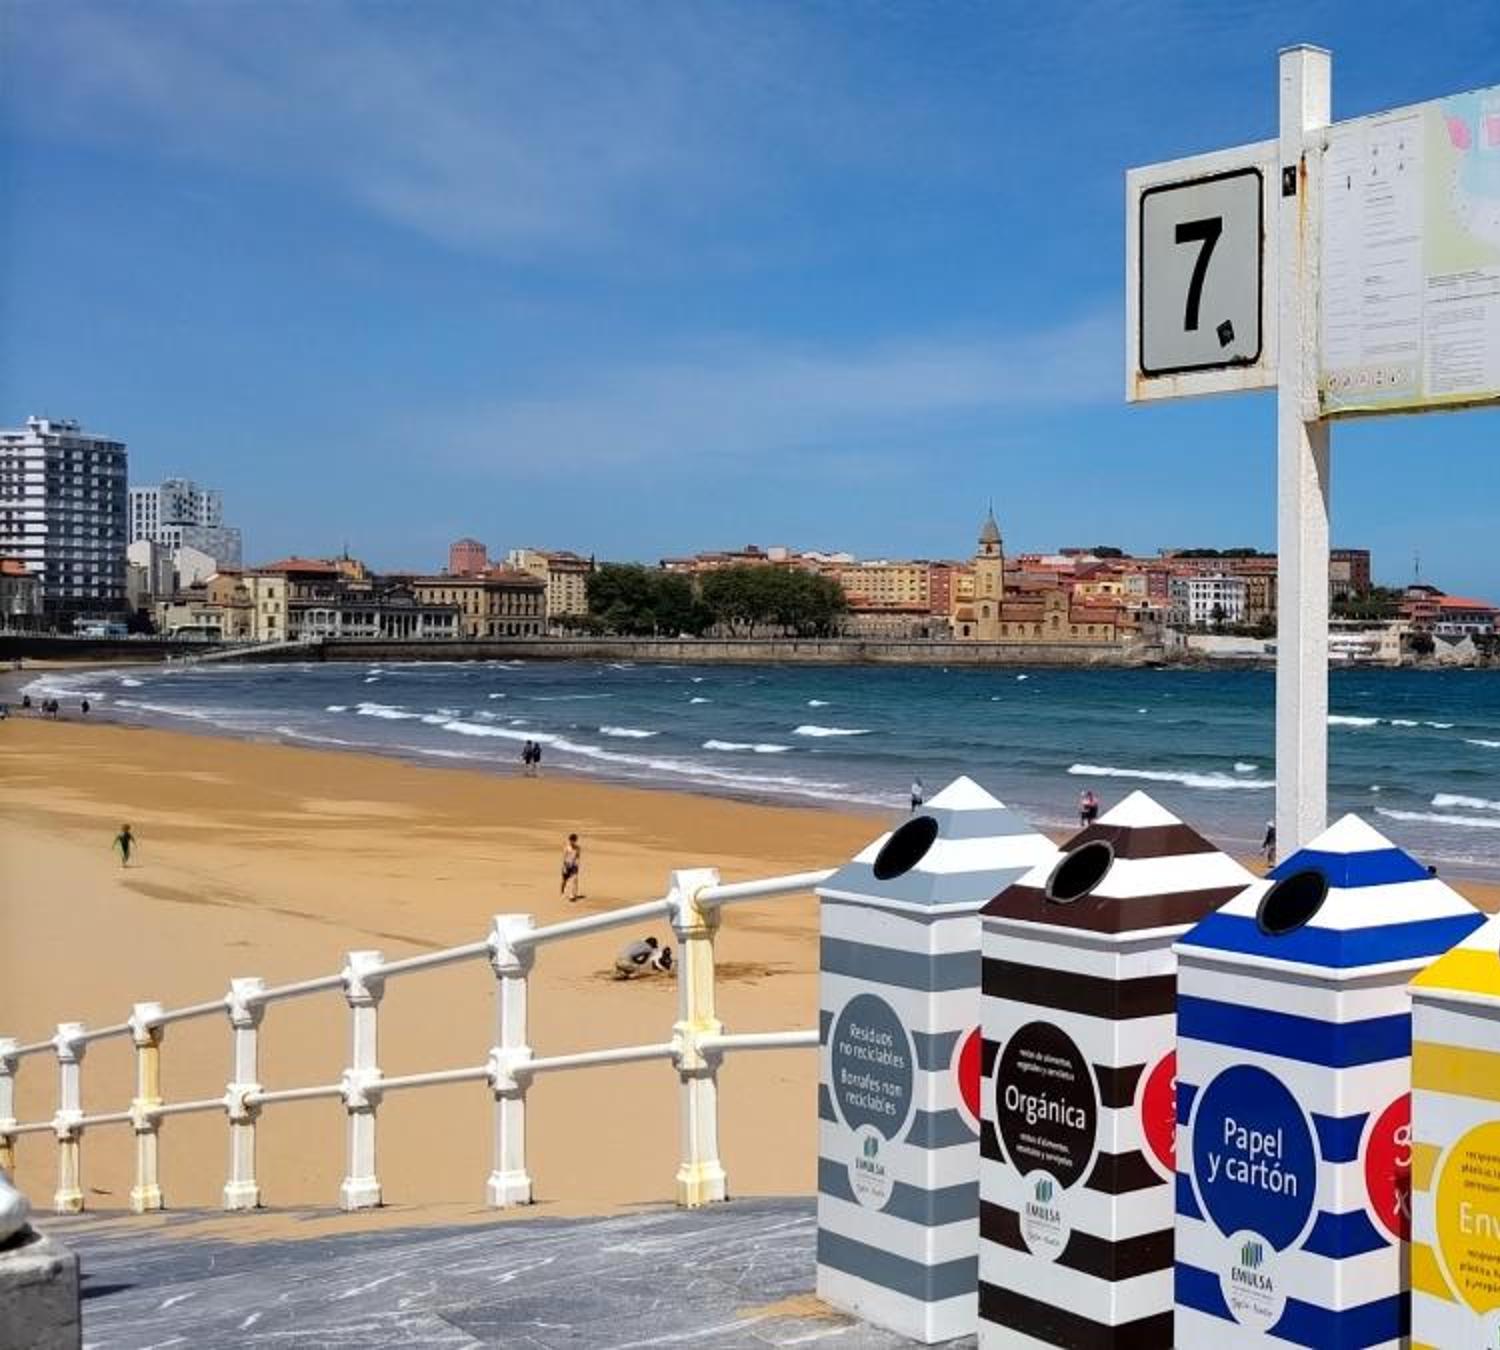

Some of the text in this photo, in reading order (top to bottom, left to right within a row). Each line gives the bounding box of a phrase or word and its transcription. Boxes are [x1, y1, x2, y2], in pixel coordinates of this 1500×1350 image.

[1175, 215, 1222, 332] 7
[850, 1023, 894, 1047] Residuos
[839, 1041, 905, 1069] no reciclables
[845, 1091, 898, 1116] reciclables
[1005, 1085, 1086, 1131] Orgánica
[1224, 1116, 1283, 1161] Papel
[1207, 1151, 1297, 1197] y cartón
[1231, 1267, 1273, 1293] EMULSA
